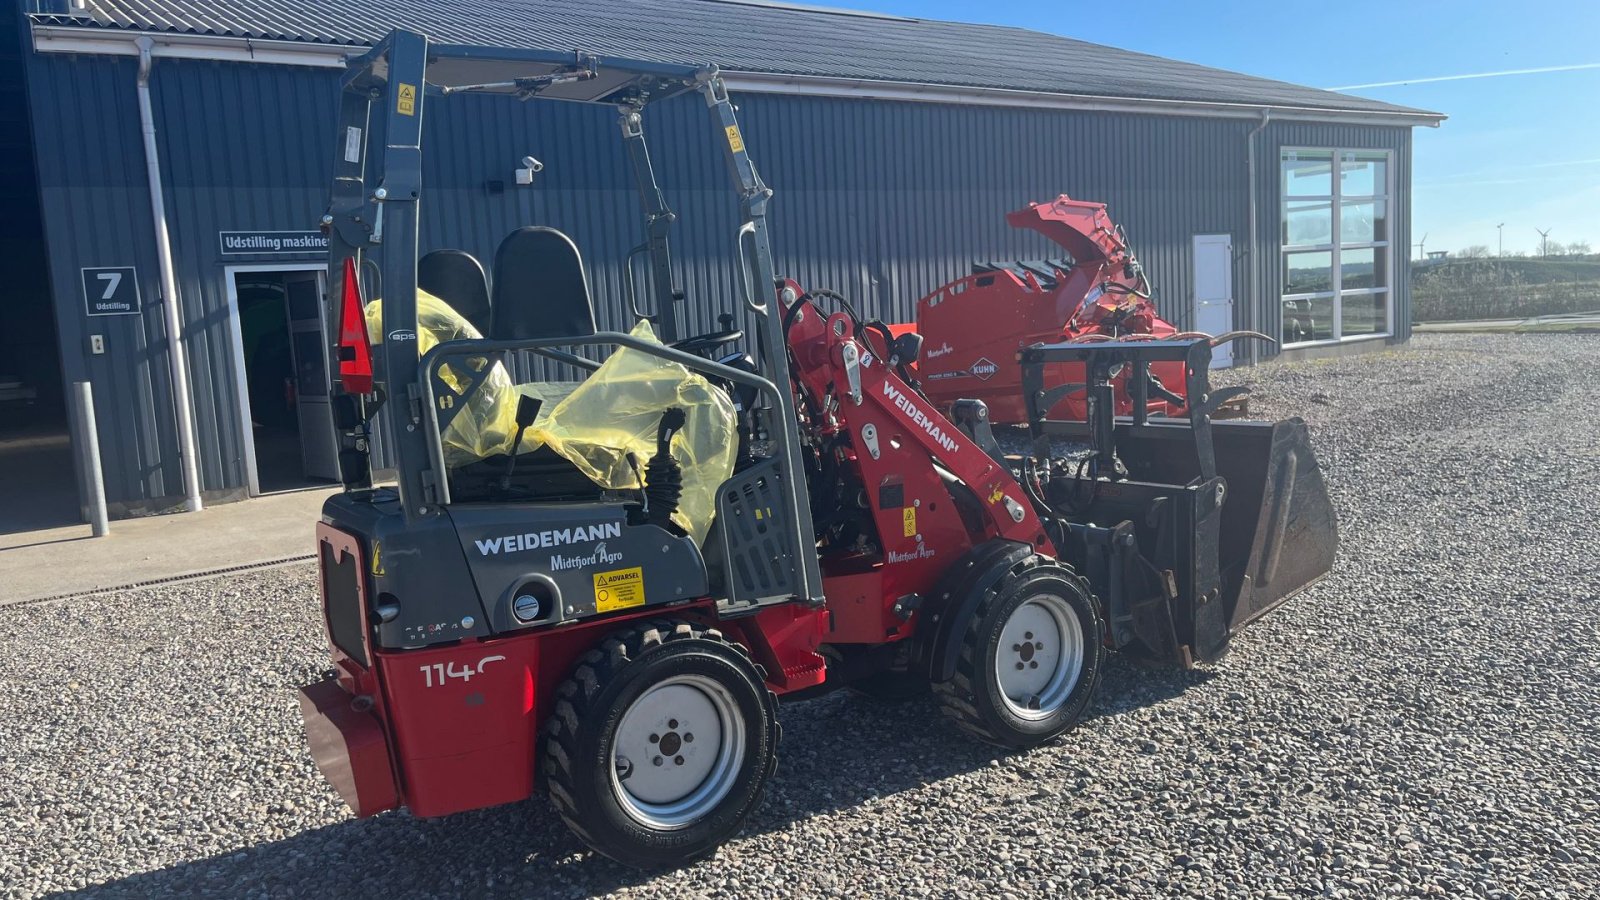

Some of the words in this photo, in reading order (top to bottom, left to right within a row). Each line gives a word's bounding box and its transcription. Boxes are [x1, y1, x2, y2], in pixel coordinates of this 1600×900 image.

[225, 236, 281, 250] Udstilling
[282, 235, 329, 248] maskine
[97, 273, 122, 300] 7
[96, 302, 130, 311] Udstilling
[392, 333, 416, 341] eps
[973, 364, 995, 375] KUHN
[883, 380, 959, 453] WEIDEMANN
[475, 521, 621, 556] WEIDEMANN
[551, 554, 596, 571] Midtfjord
[599, 547, 623, 564] Agro
[888, 550, 918, 564] Midtfjord
[919, 545, 935, 558] Agro
[608, 572, 640, 582] ADVARSEL
